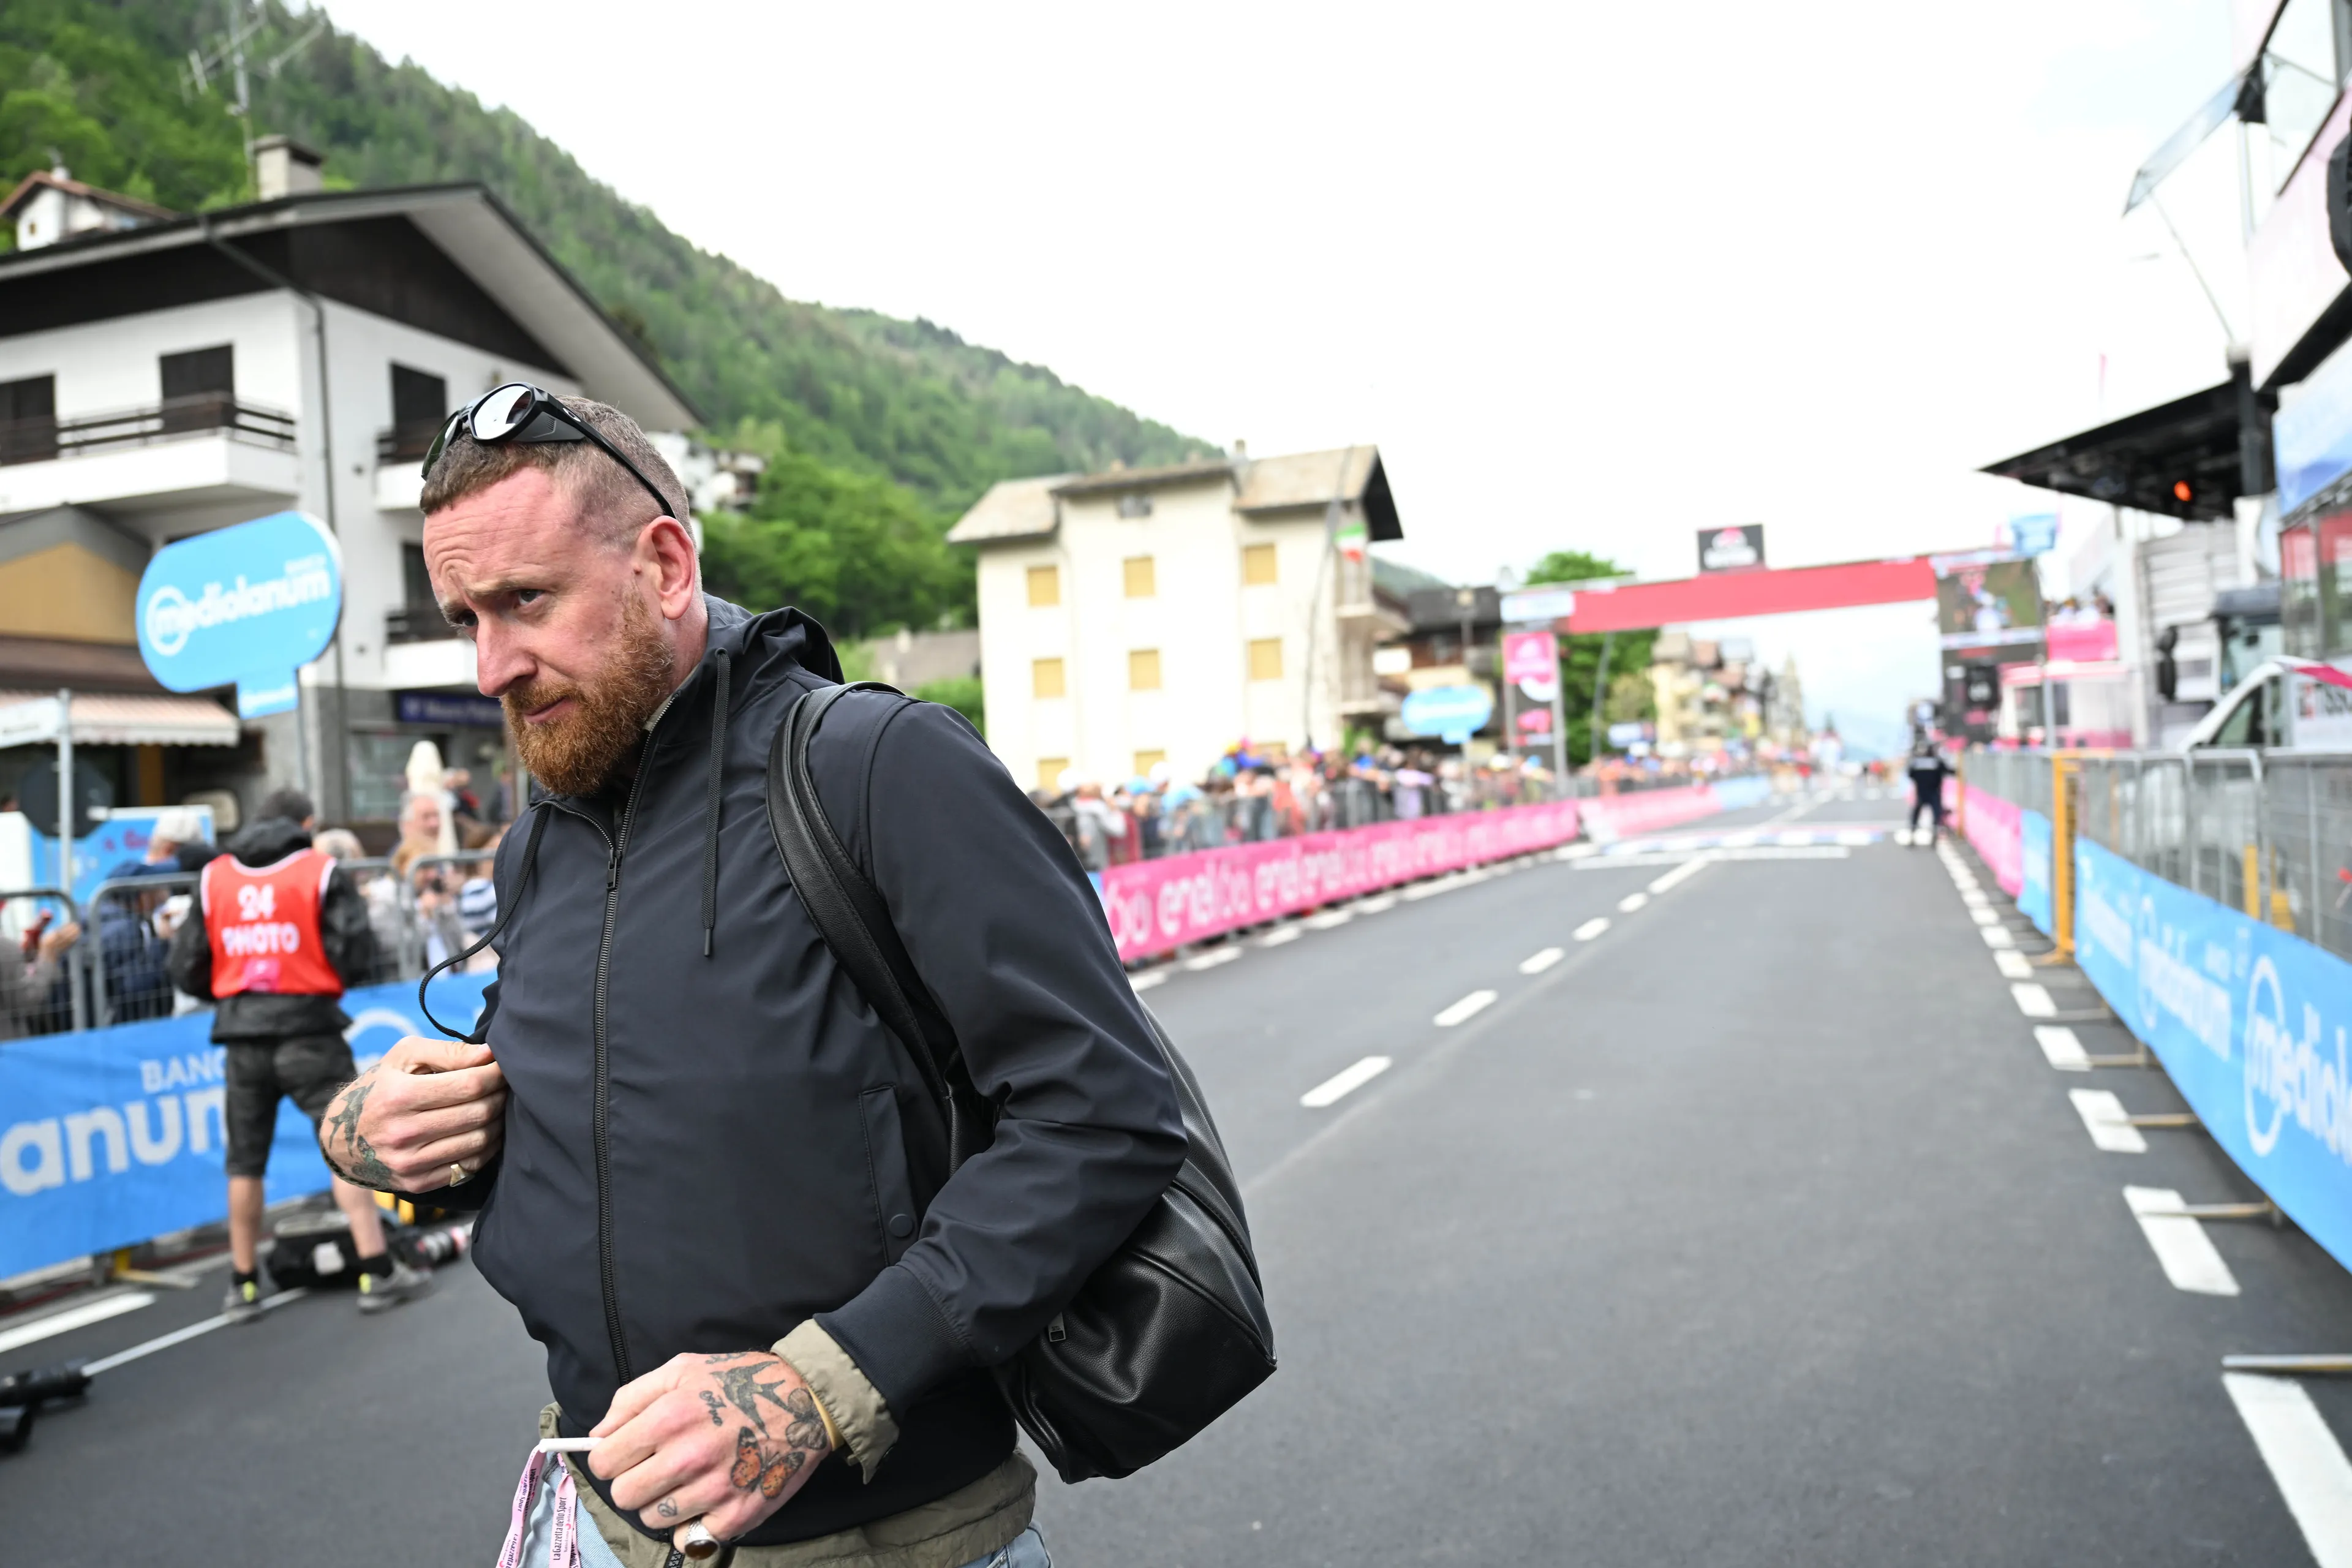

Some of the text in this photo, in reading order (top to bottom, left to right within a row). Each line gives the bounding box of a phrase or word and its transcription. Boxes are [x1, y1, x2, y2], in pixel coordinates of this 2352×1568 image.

[238, 884, 277, 921] 24
[221, 922, 301, 956] PHOTO
[2244, 954, 2352, 1167] mediol
[555, 1513, 565, 1527] dello
[556, 1497, 567, 1512] Sport
